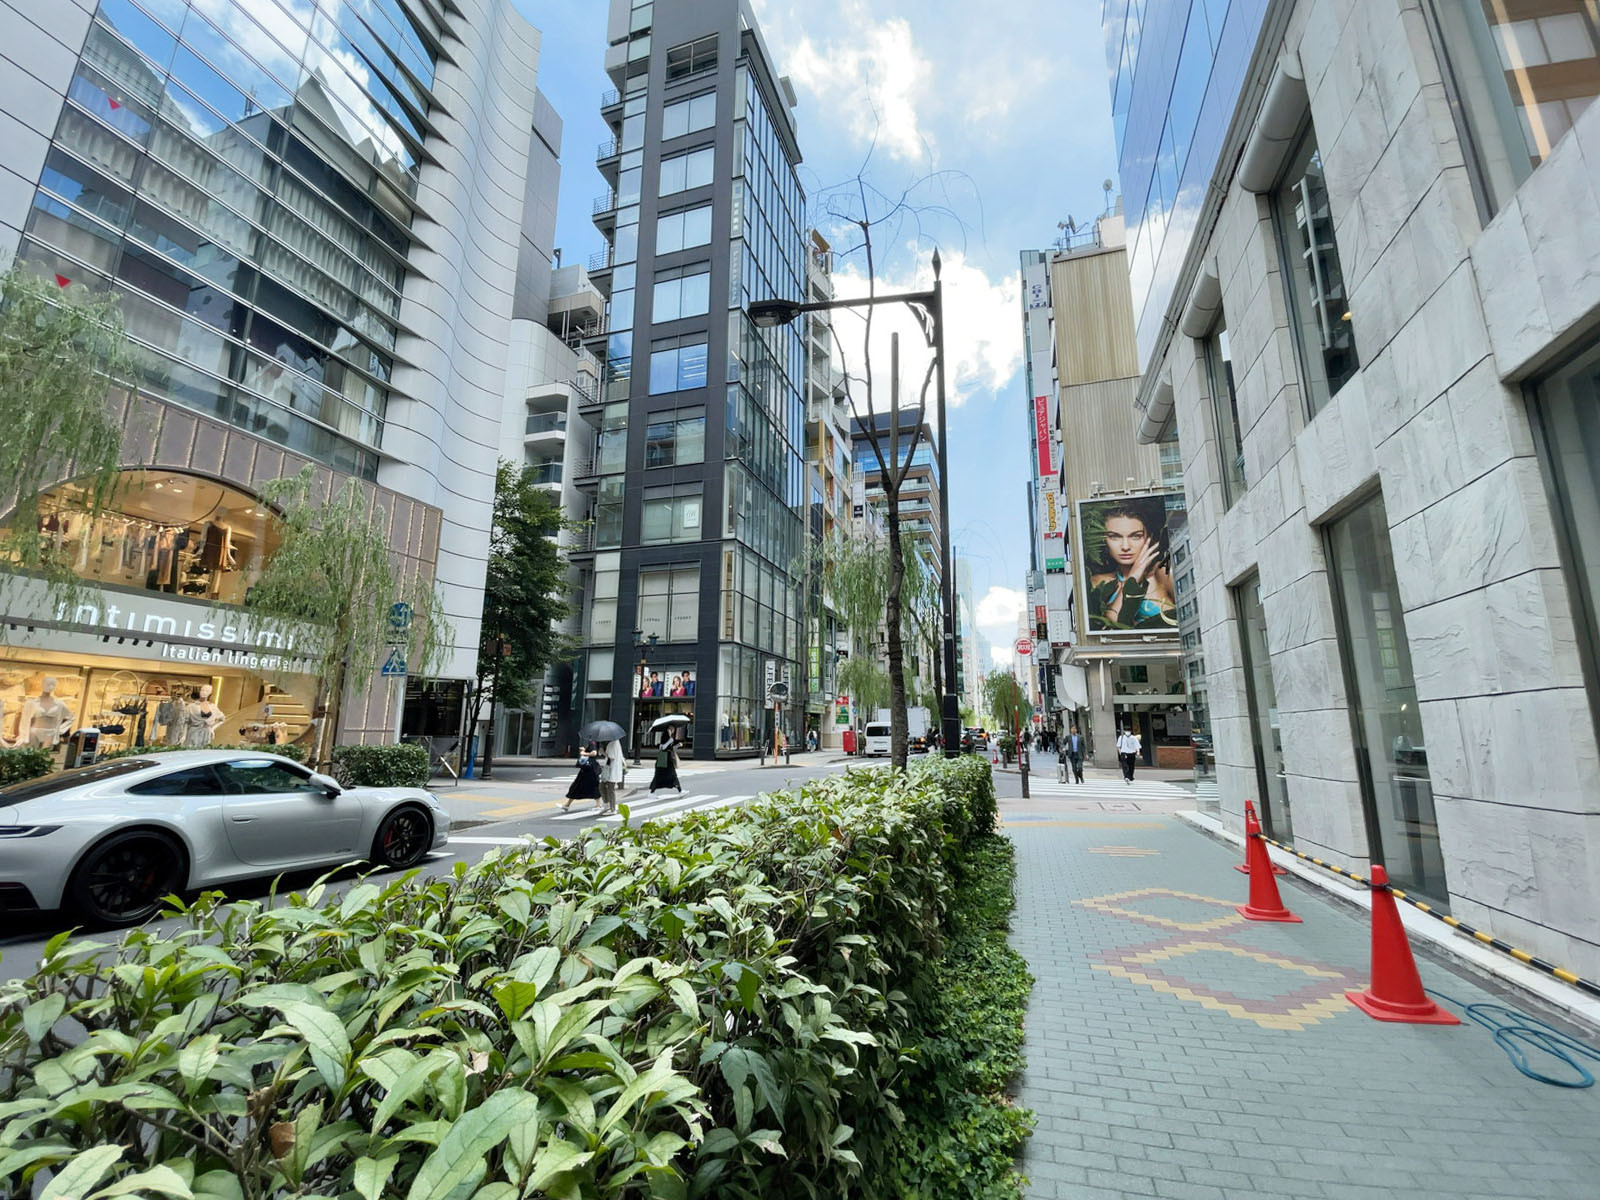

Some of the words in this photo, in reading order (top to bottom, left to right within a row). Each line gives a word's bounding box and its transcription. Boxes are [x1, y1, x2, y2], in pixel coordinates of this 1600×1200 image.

[56, 601, 294, 650] intimissimi
[162, 643, 221, 662] Italian
[228, 650, 289, 671] lingerie
